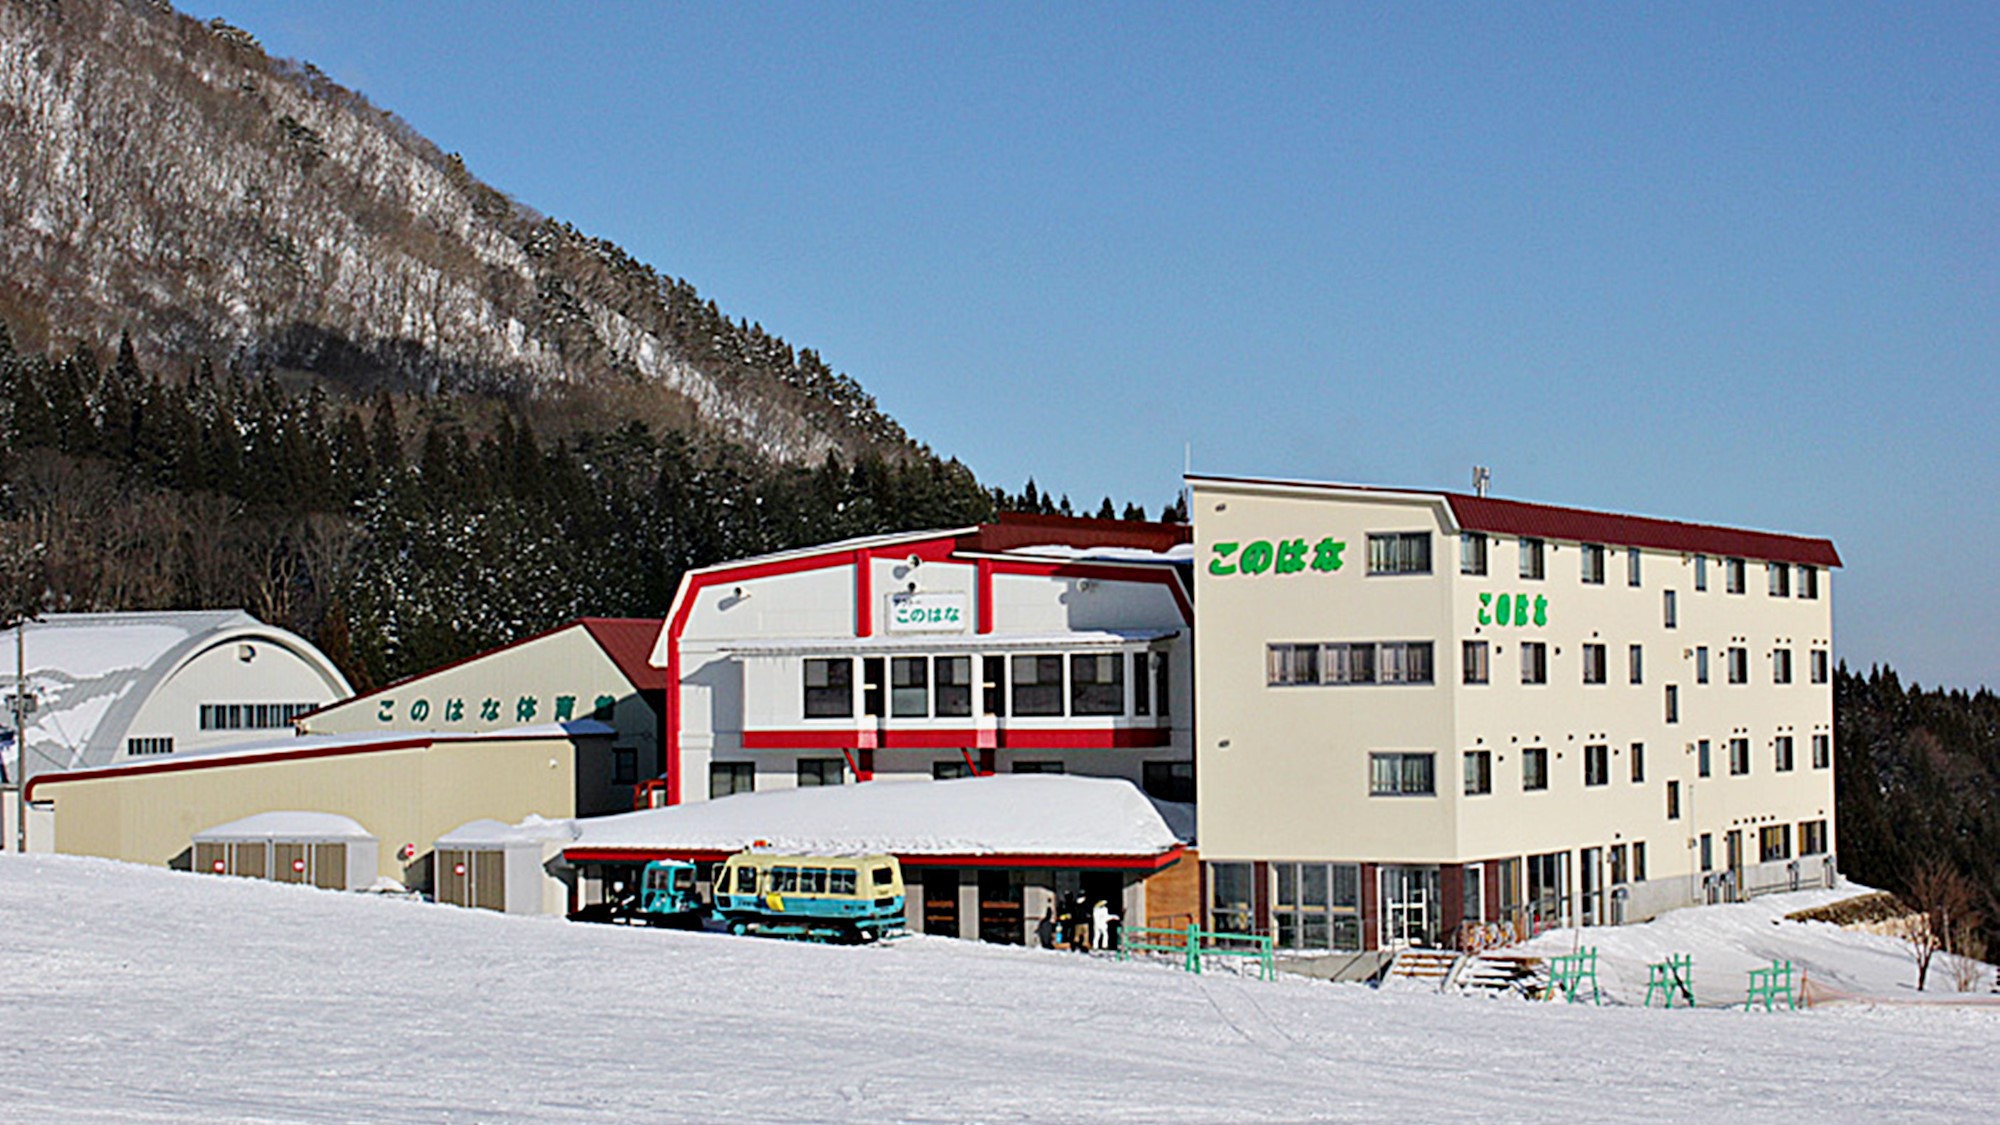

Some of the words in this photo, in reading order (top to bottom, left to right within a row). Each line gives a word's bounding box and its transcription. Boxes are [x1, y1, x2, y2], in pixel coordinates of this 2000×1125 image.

[1209, 537, 1346, 575] このはな
[896, 607, 960, 624] このはな
[1478, 592, 1548, 627] このはな
